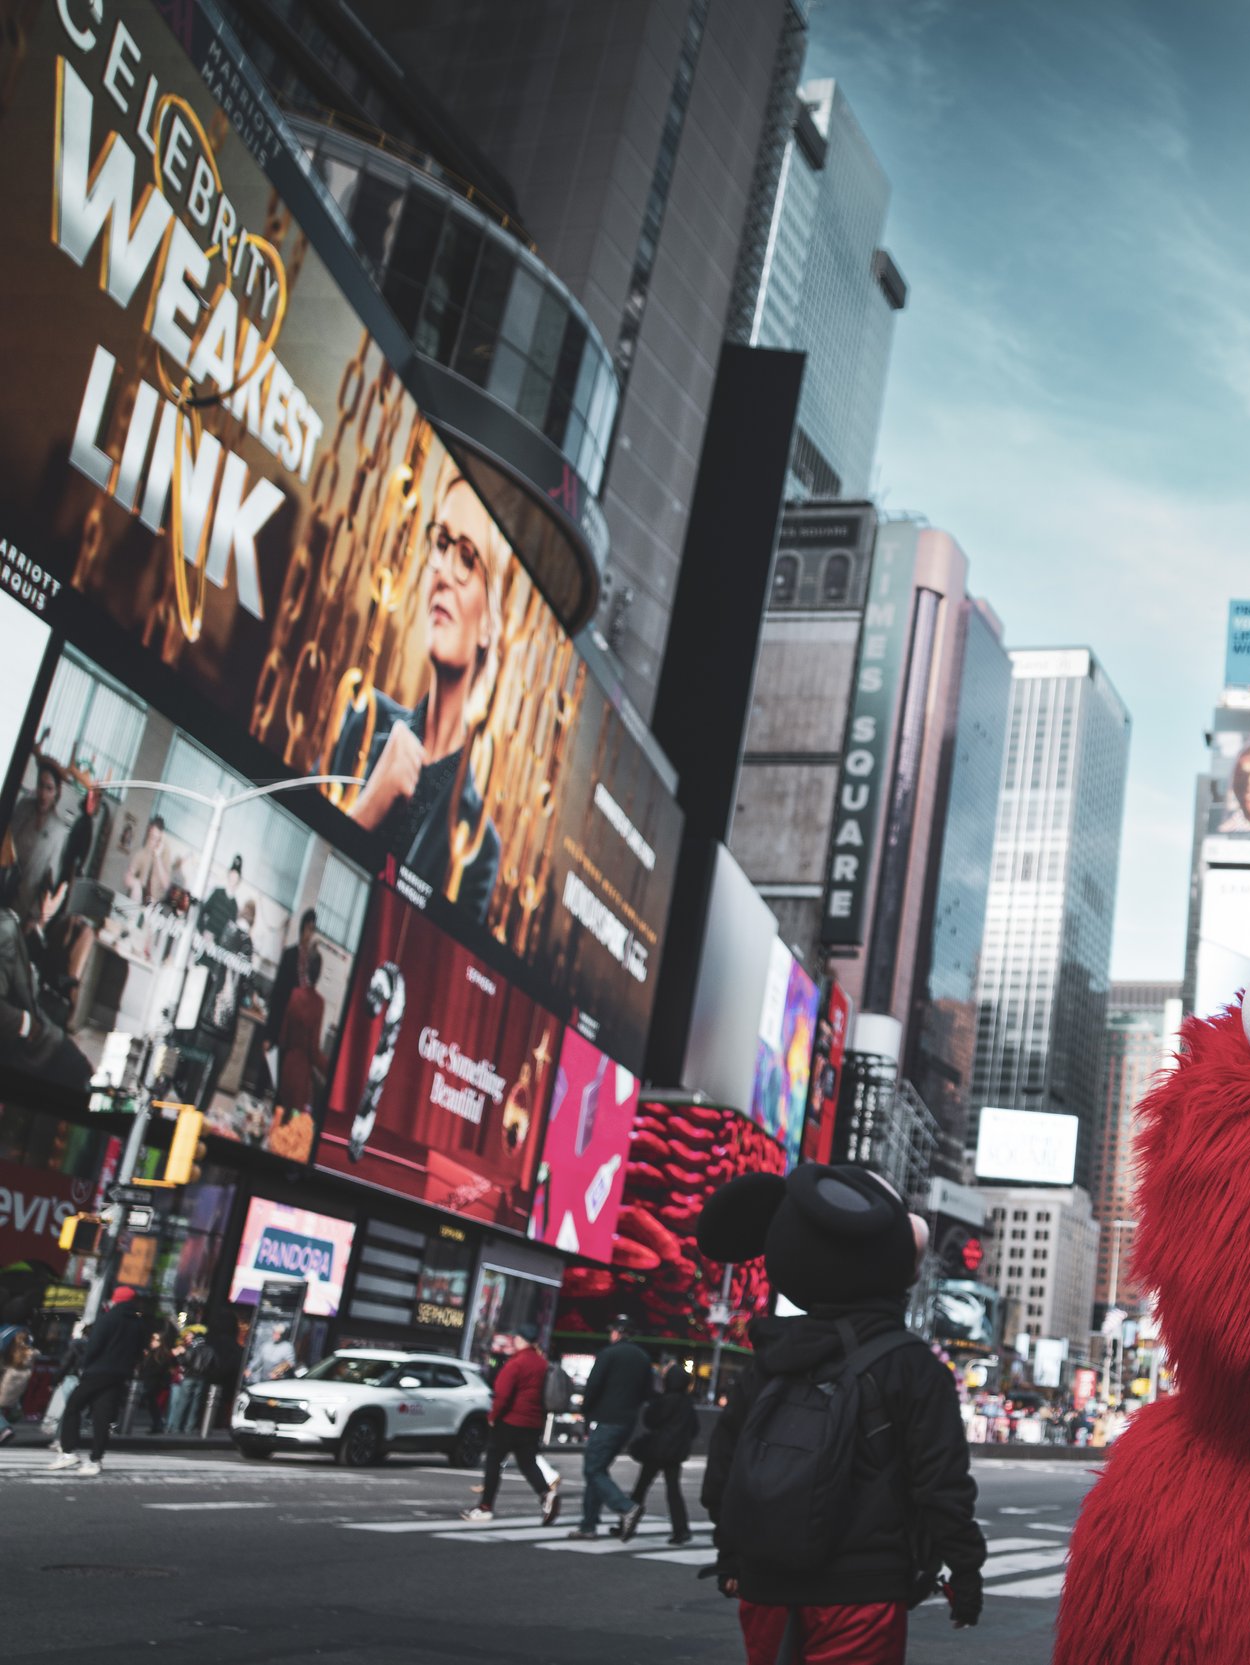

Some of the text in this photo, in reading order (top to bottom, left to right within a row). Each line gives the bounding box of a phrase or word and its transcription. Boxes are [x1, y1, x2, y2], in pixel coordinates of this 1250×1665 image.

[57, 0, 279, 319] CELEBRITY
[200, 62, 268, 167] MARQUIS
[208, 39, 282, 158] MARRIOTT
[52, 54, 324, 486] WEAKEST
[68, 344, 287, 622] LINK
[828, 542, 898, 919] TIMES SQUARE
